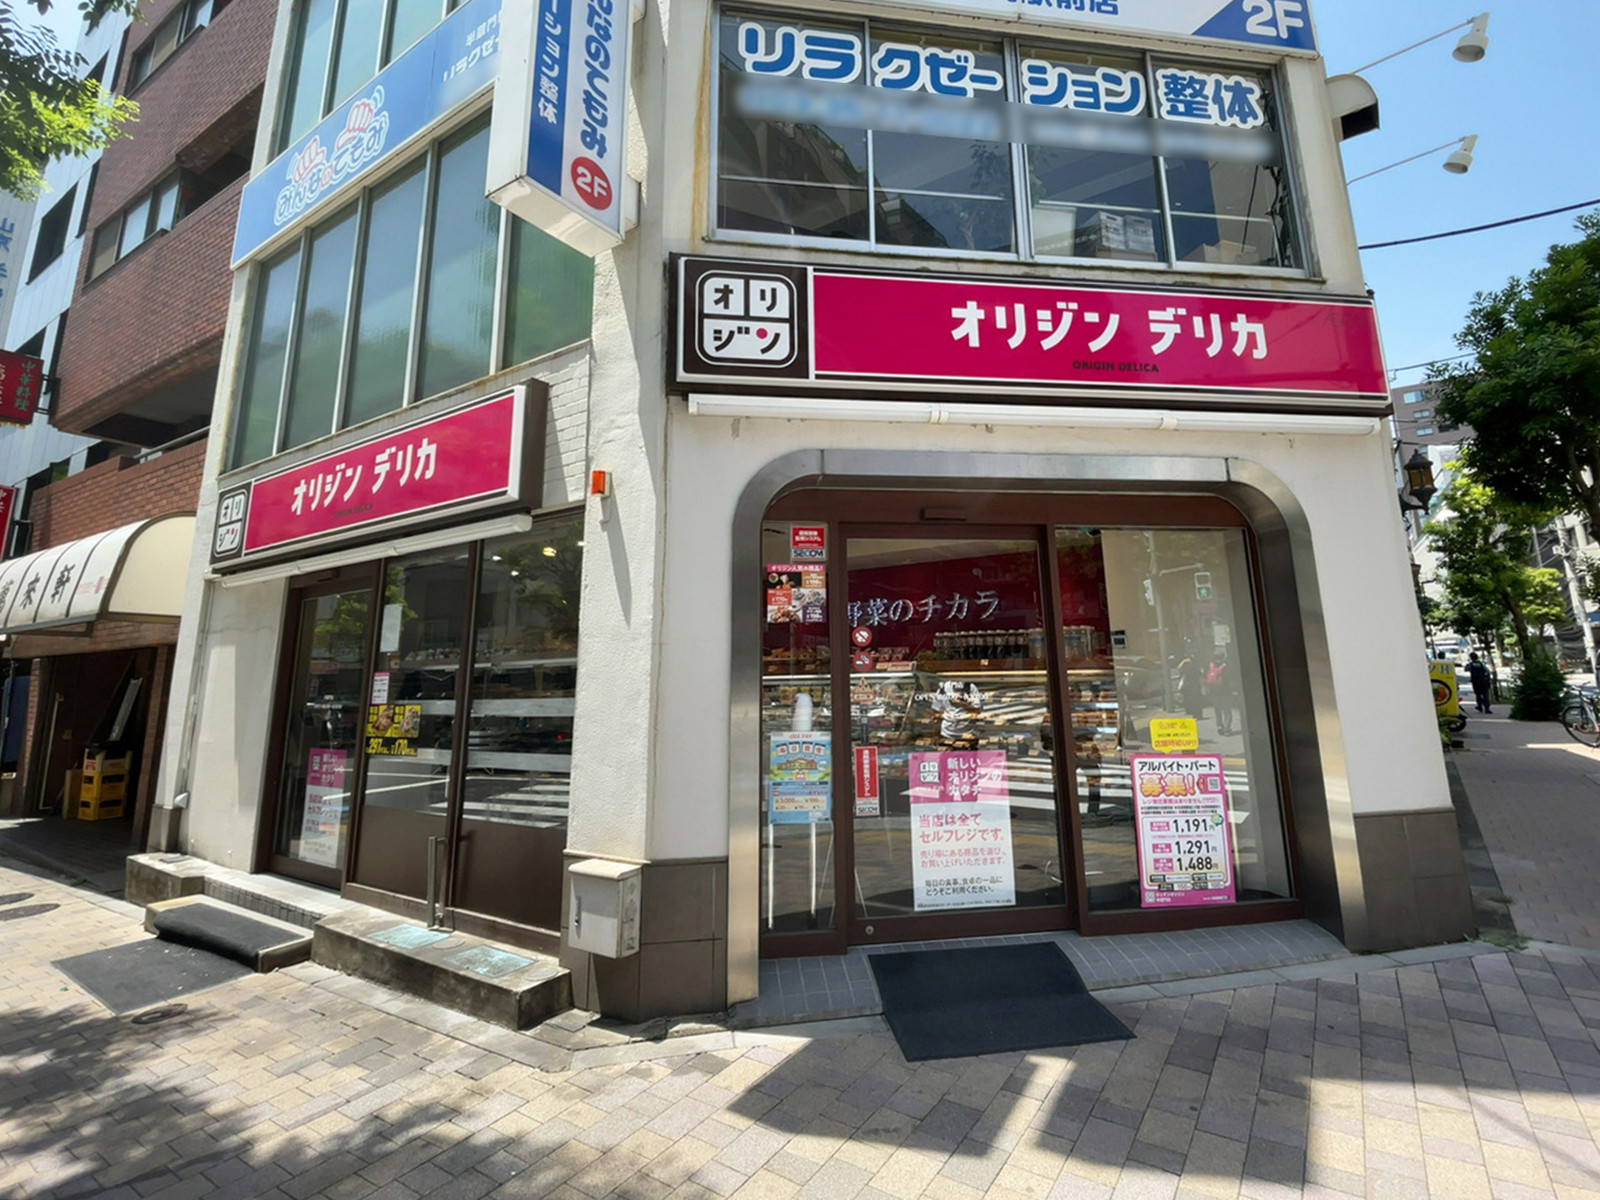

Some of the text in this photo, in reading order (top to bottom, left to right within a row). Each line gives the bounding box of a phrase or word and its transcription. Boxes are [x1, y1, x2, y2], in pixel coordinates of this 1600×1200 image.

[1243, 0, 1304, 39] 2F
[575, 165, 608, 198] 2F
[951, 300, 1269, 360] オリジン デリカ
[1072, 360, 1159, 373] ORIGIN DELICA
[291, 437, 438, 516] オリジン デリカ
[918, 827, 1004, 844] セルフレジです。
[919, 813, 982, 828] 当店は全て
